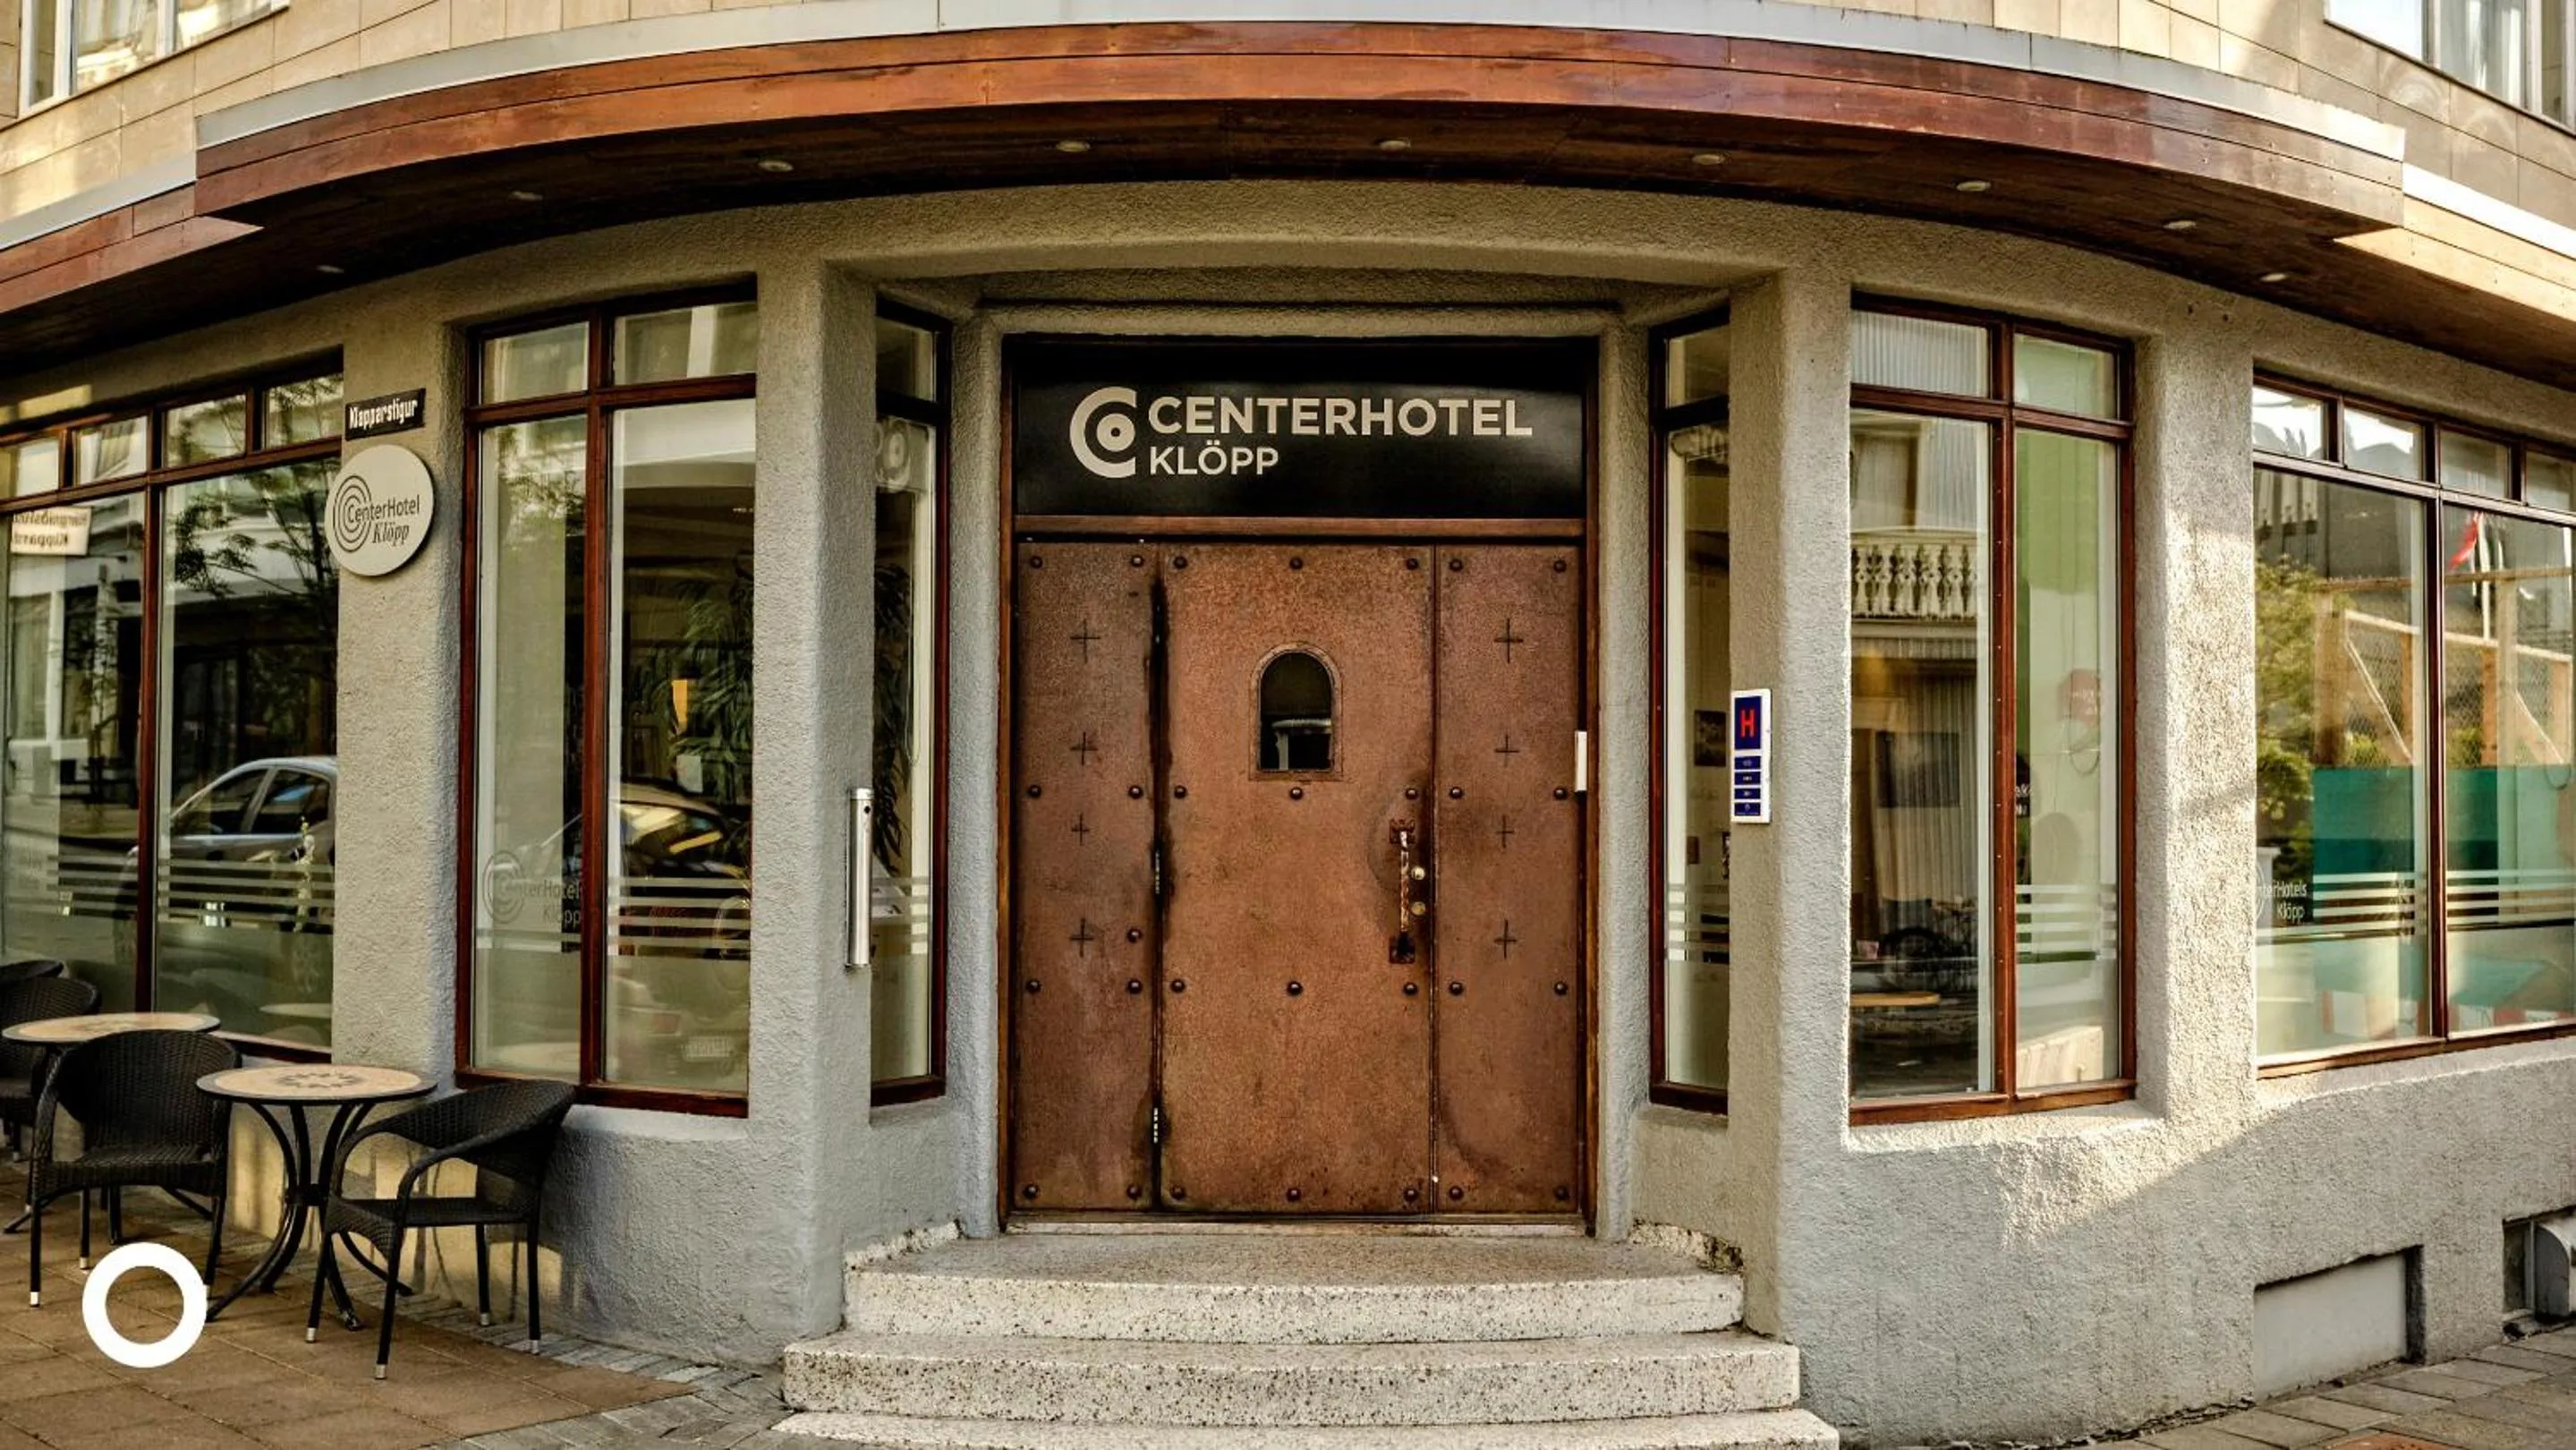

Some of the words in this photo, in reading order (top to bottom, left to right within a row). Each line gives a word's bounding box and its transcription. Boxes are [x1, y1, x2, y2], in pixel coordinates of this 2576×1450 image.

[1148, 396, 1533, 437] CENTERHOTEL
[1150, 439, 1279, 475] KLÖPP
[348, 494, 421, 524] CenterHotel
[371, 521, 410, 547] Klöpp
[1740, 708, 1756, 738] H
